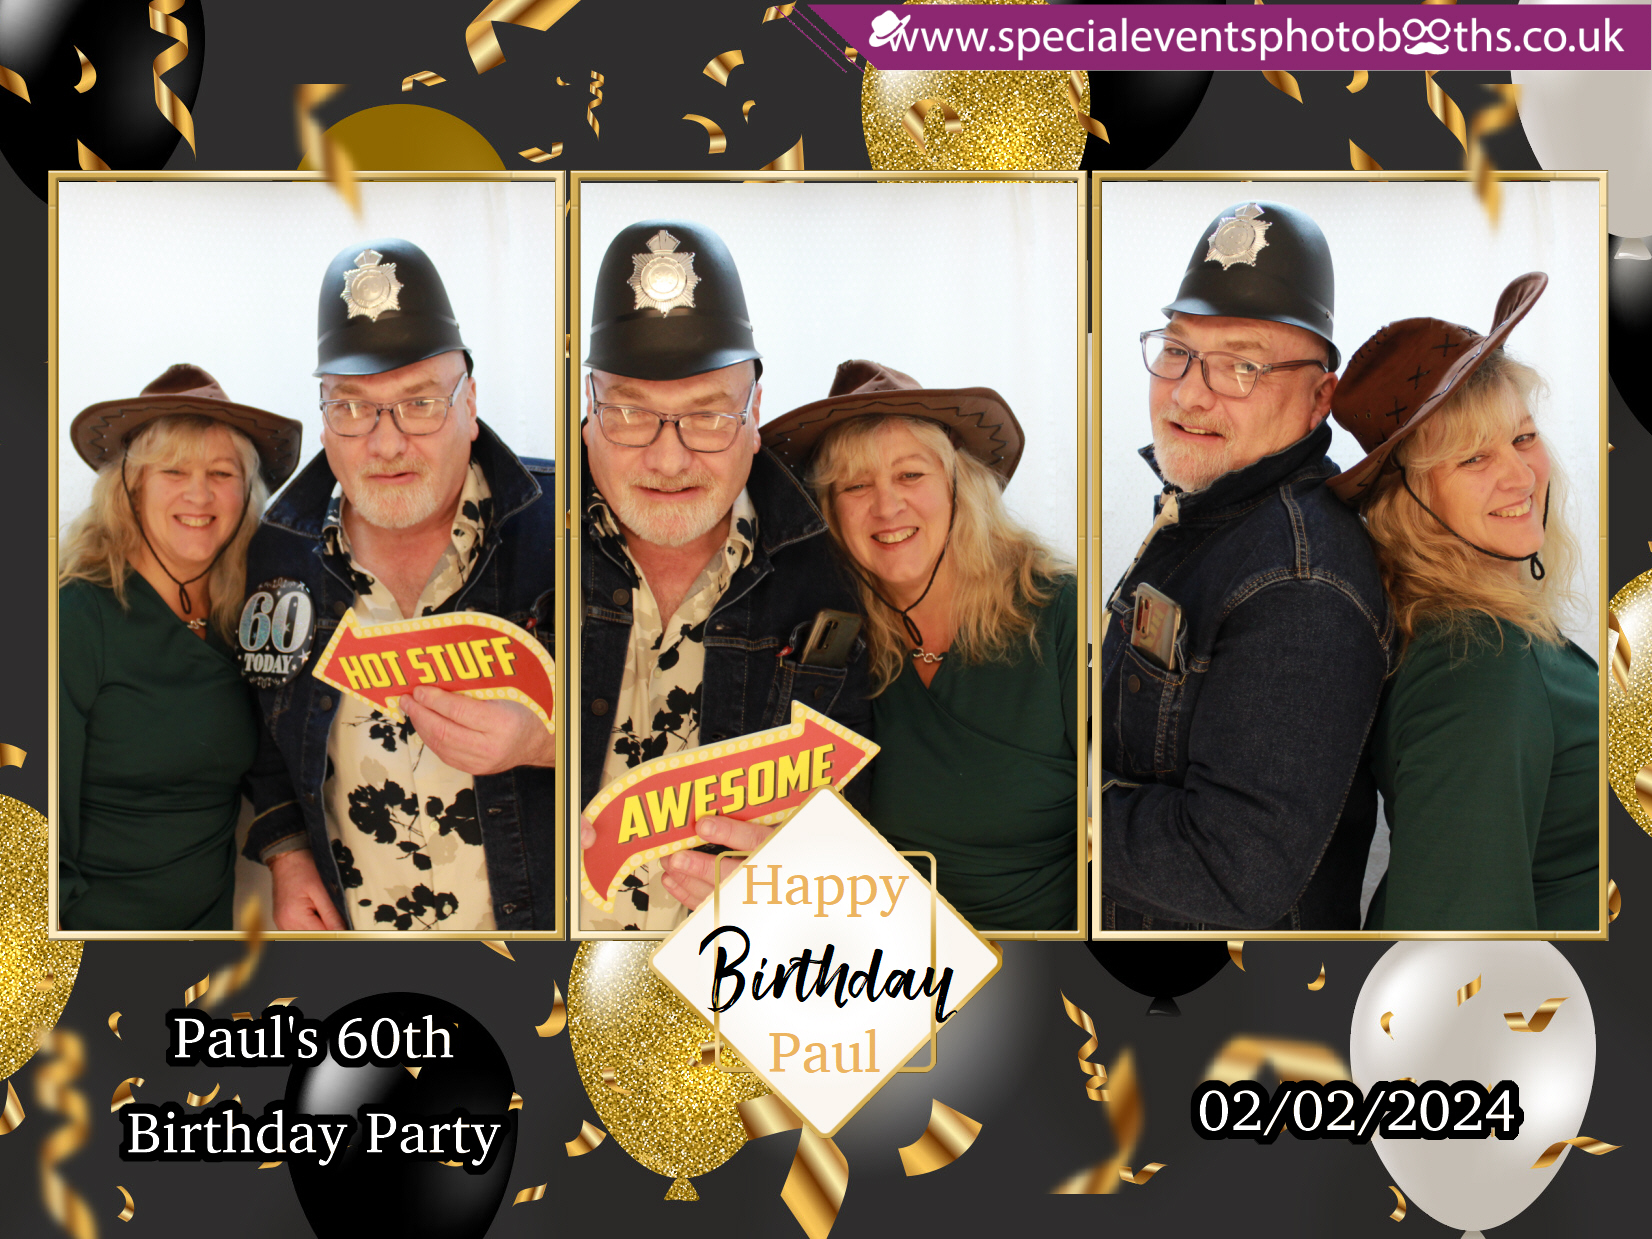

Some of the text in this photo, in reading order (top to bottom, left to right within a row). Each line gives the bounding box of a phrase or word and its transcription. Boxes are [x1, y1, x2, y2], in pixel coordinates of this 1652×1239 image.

[238, 591, 312, 654] 60
[244, 653, 294, 675] TODAY
[338, 636, 517, 690] HOT STUFF
[617, 743, 834, 844] AWESOME
